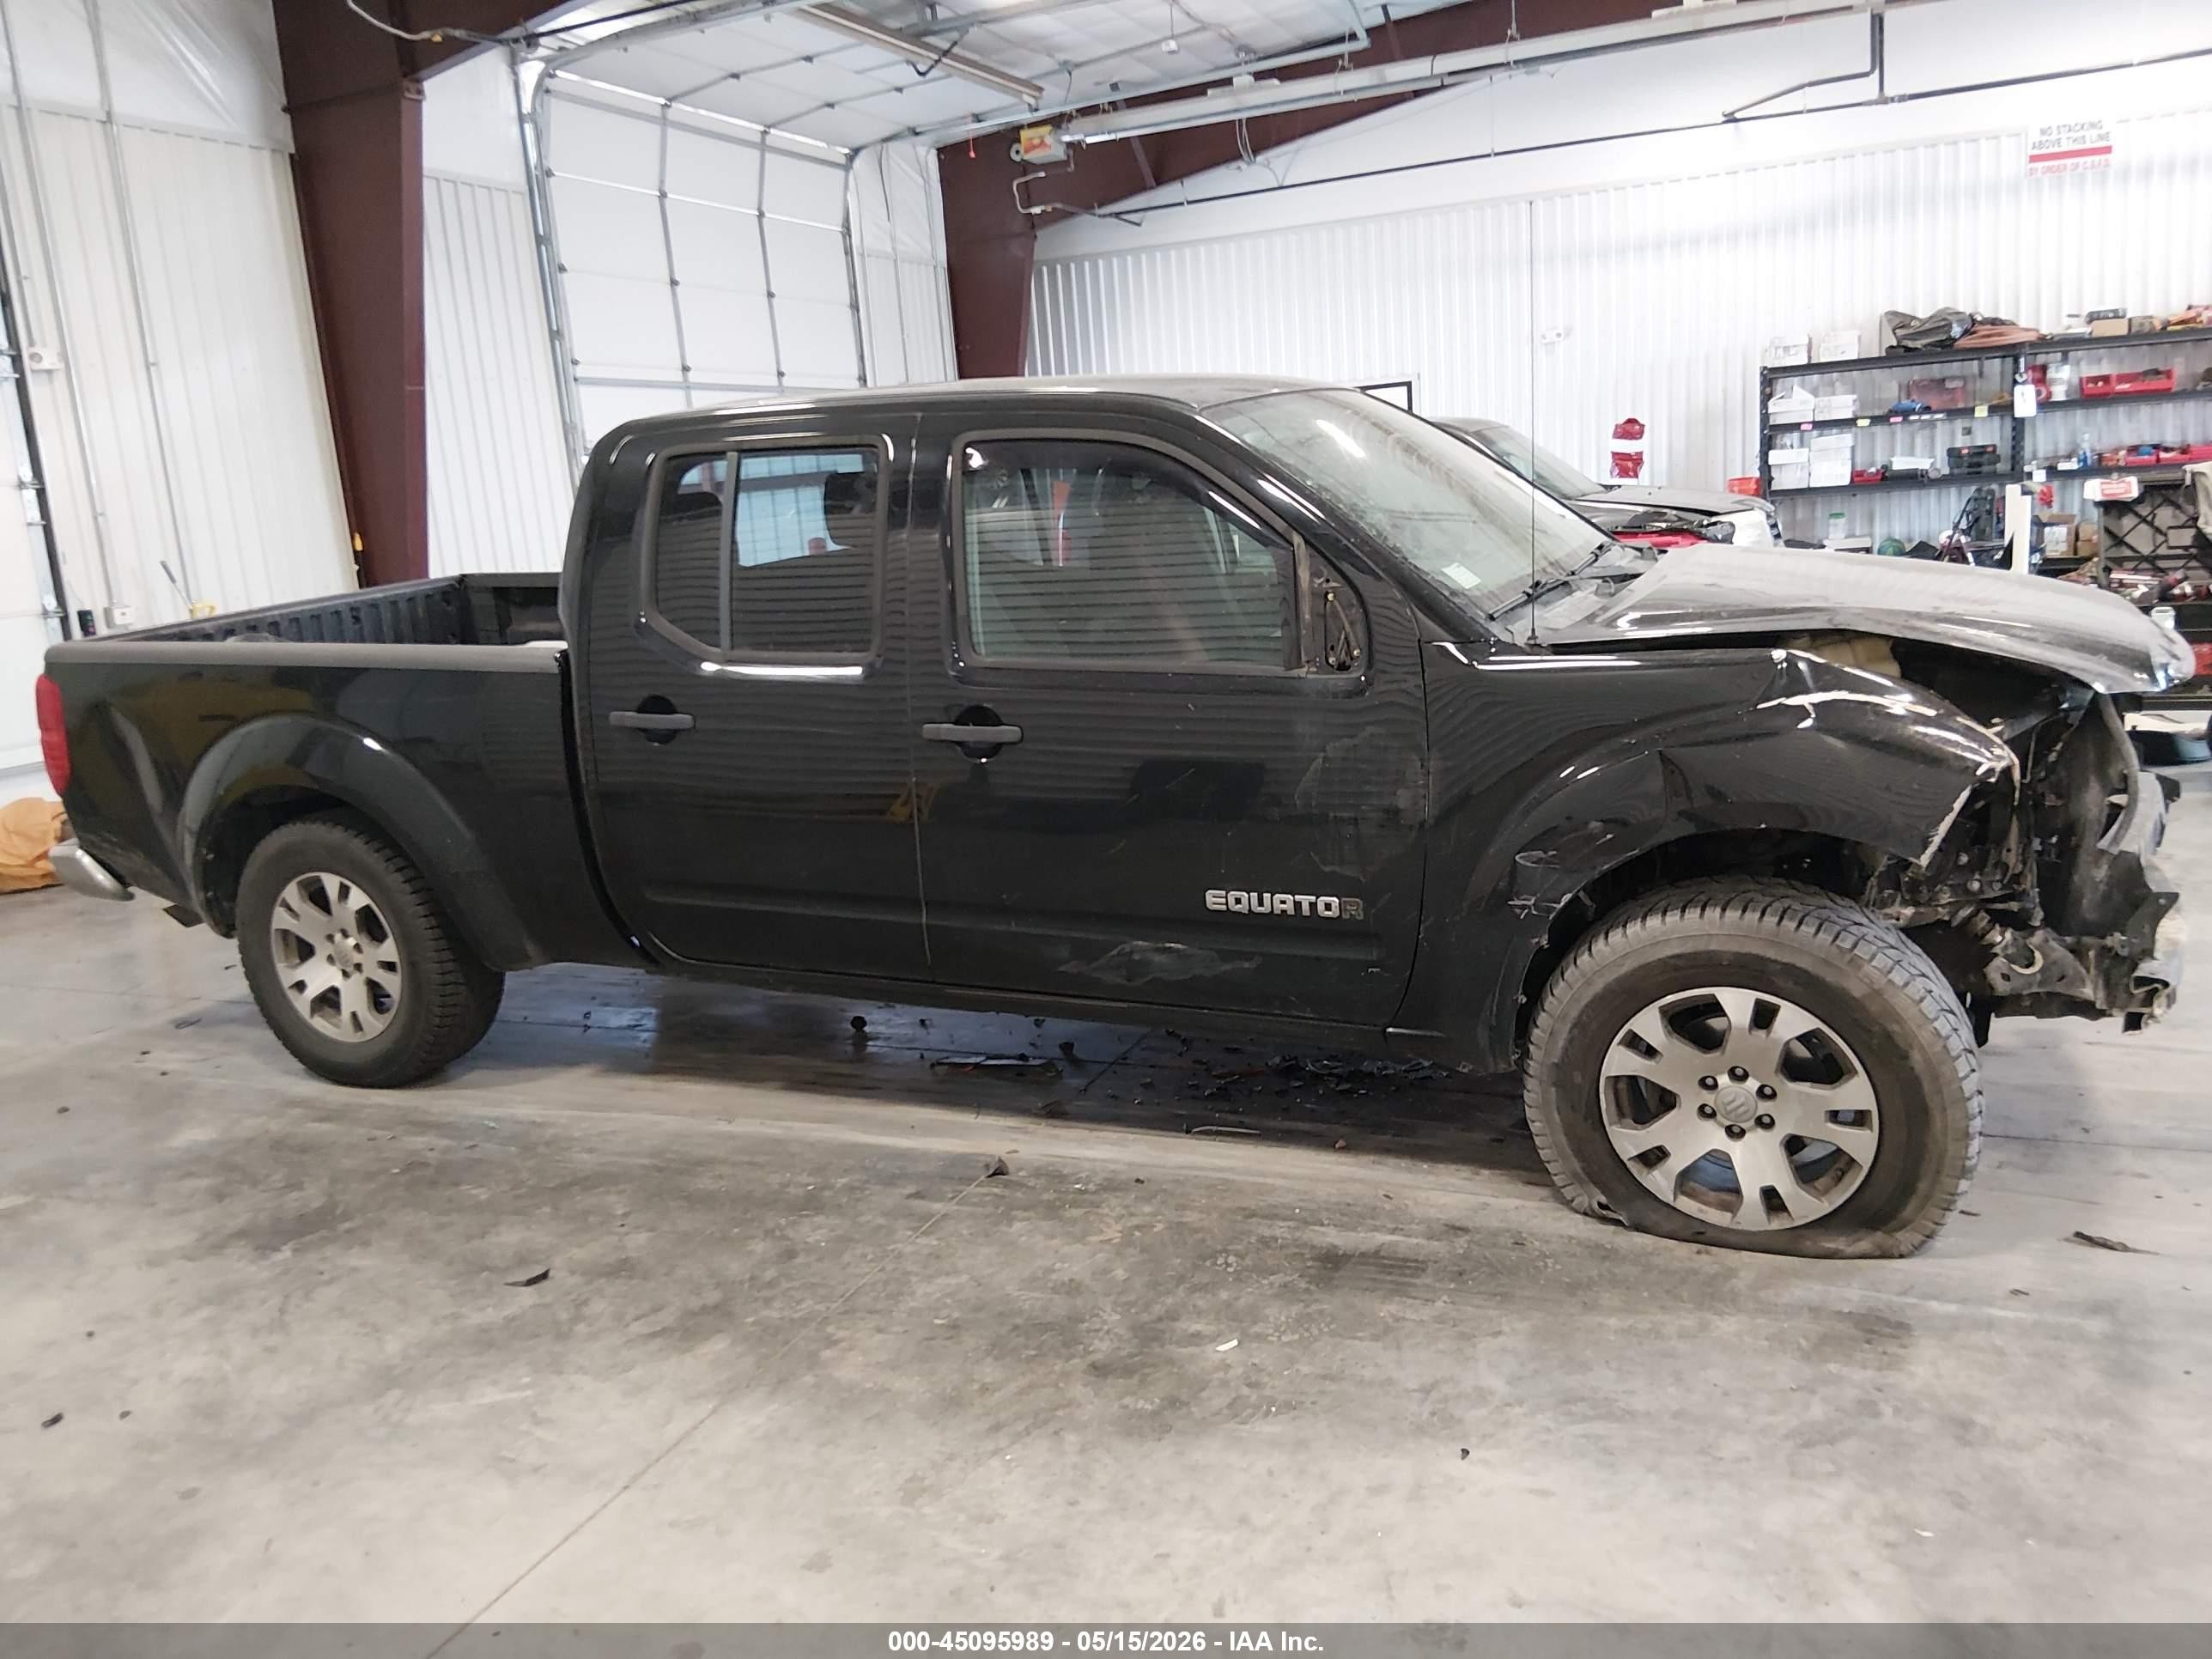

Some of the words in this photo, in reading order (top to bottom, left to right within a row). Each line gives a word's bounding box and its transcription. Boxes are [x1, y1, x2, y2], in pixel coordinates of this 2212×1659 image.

[2039, 126, 2053, 137] NO
[2057, 119, 2103, 135] STACKING
[2032, 137, 2062, 150] ABOVE
[2066, 135, 2086, 145] THIS
[2089, 131, 2111, 143] LINE
[2041, 164, 2068, 175] ORDER
[2069, 161, 2080, 172] OF
[1205, 890, 1364, 920] EQUATOR
